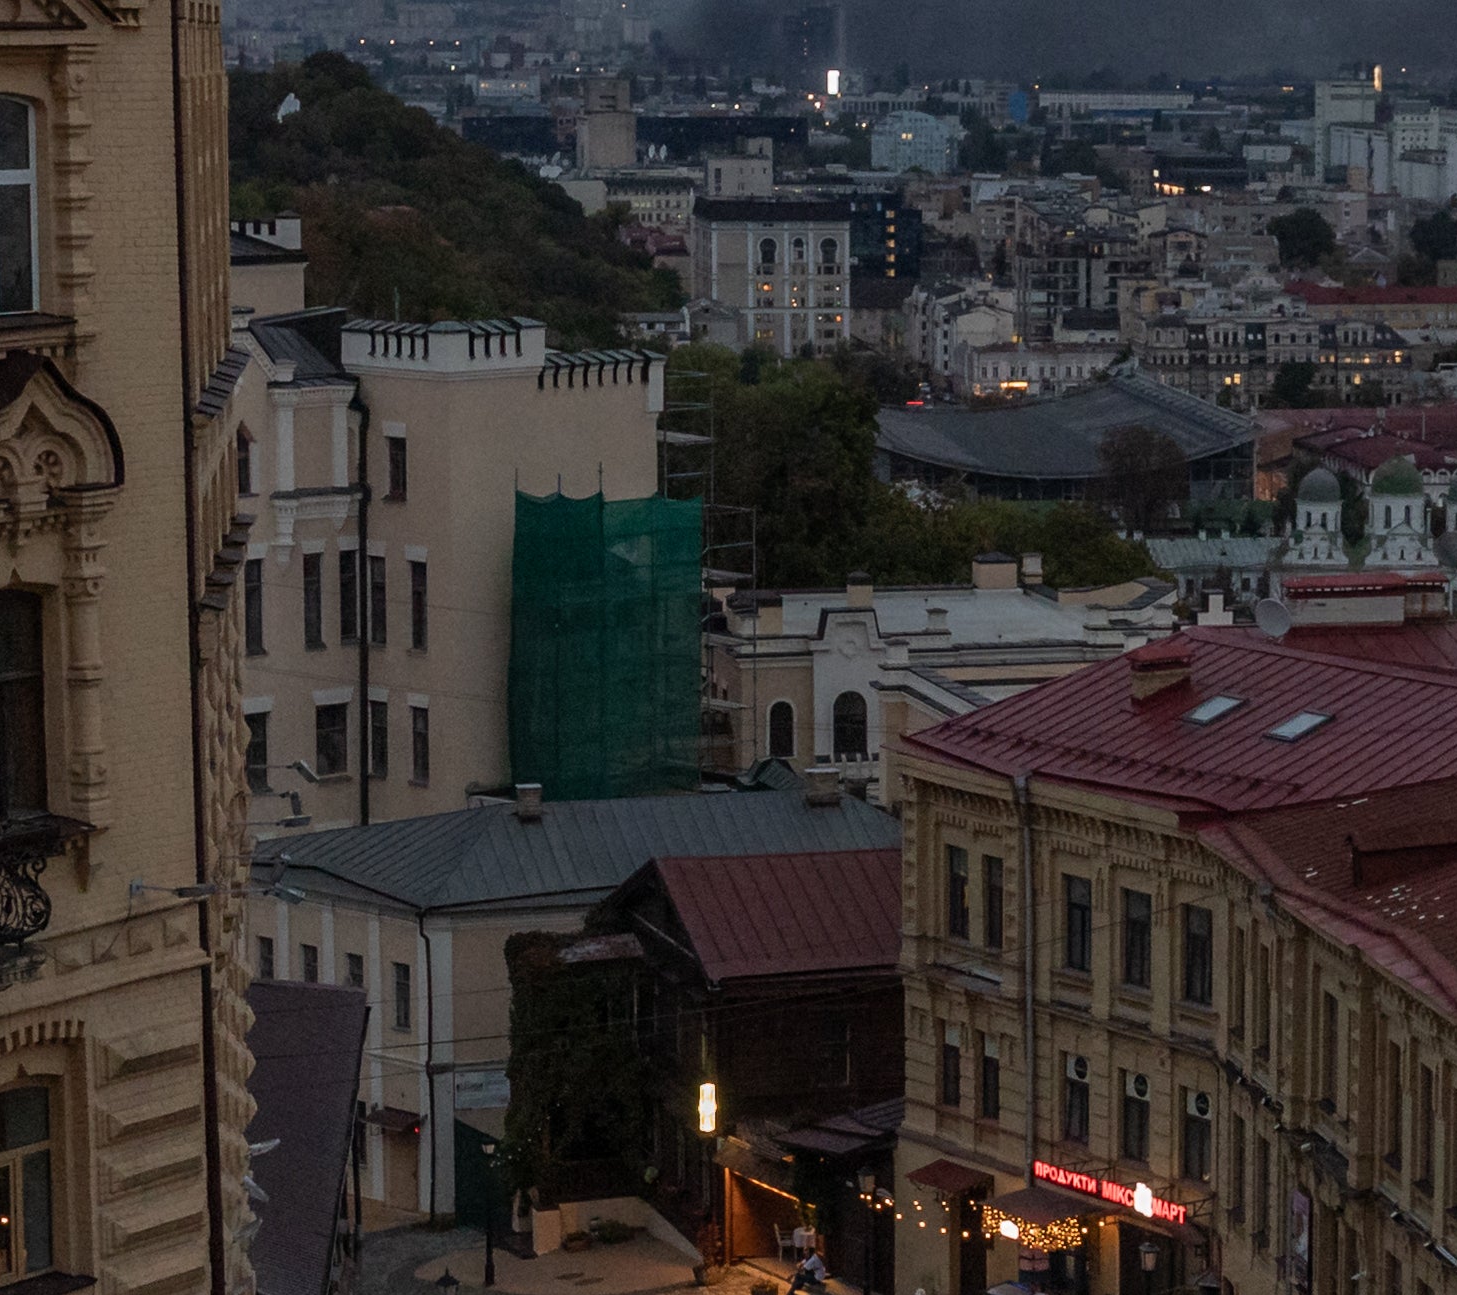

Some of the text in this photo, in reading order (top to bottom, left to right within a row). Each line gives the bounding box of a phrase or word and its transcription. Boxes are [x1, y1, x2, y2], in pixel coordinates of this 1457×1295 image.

[1034, 1160, 1187, 1225] ПРОДУКТИ МІКС МАРТ
